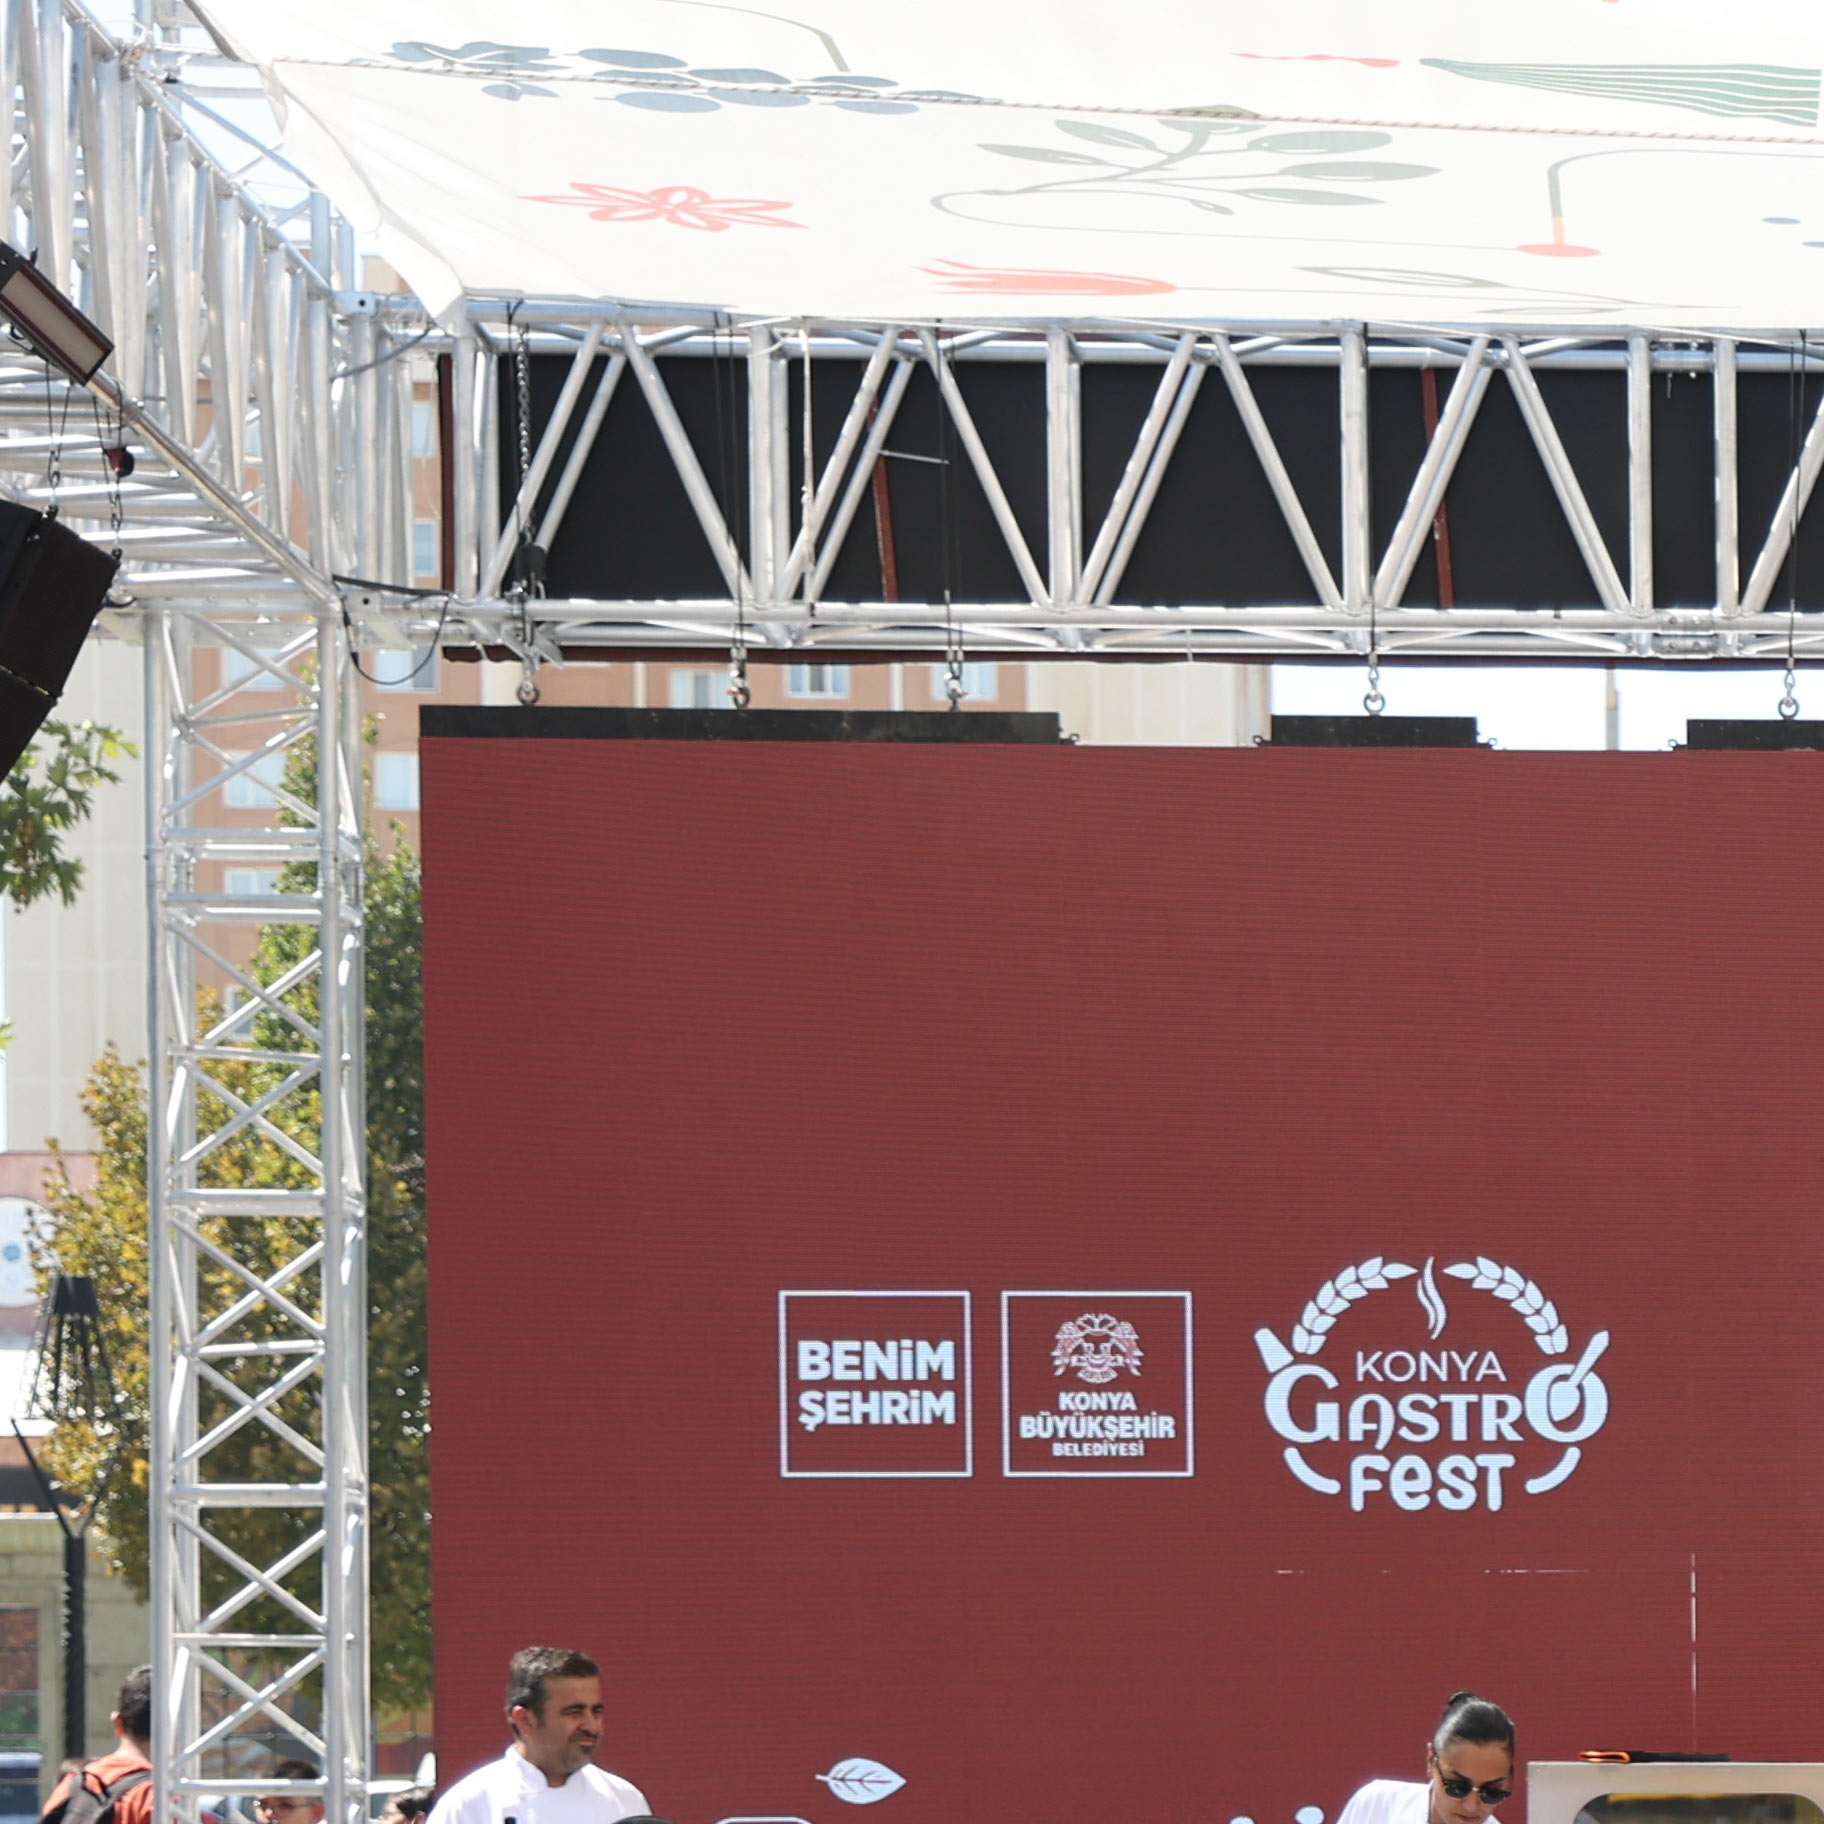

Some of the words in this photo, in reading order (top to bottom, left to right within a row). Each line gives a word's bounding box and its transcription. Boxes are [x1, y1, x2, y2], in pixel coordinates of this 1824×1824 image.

[1356, 1350, 1507, 1382] KONYA
[1058, 1391, 1138, 1412] KONYA
[1264, 1363, 1608, 1450] GASTRO
[1019, 1409, 1176, 1442] BÜYÜKŞEHİR
[1051, 1440, 1145, 1457] BELEDİYESİ
